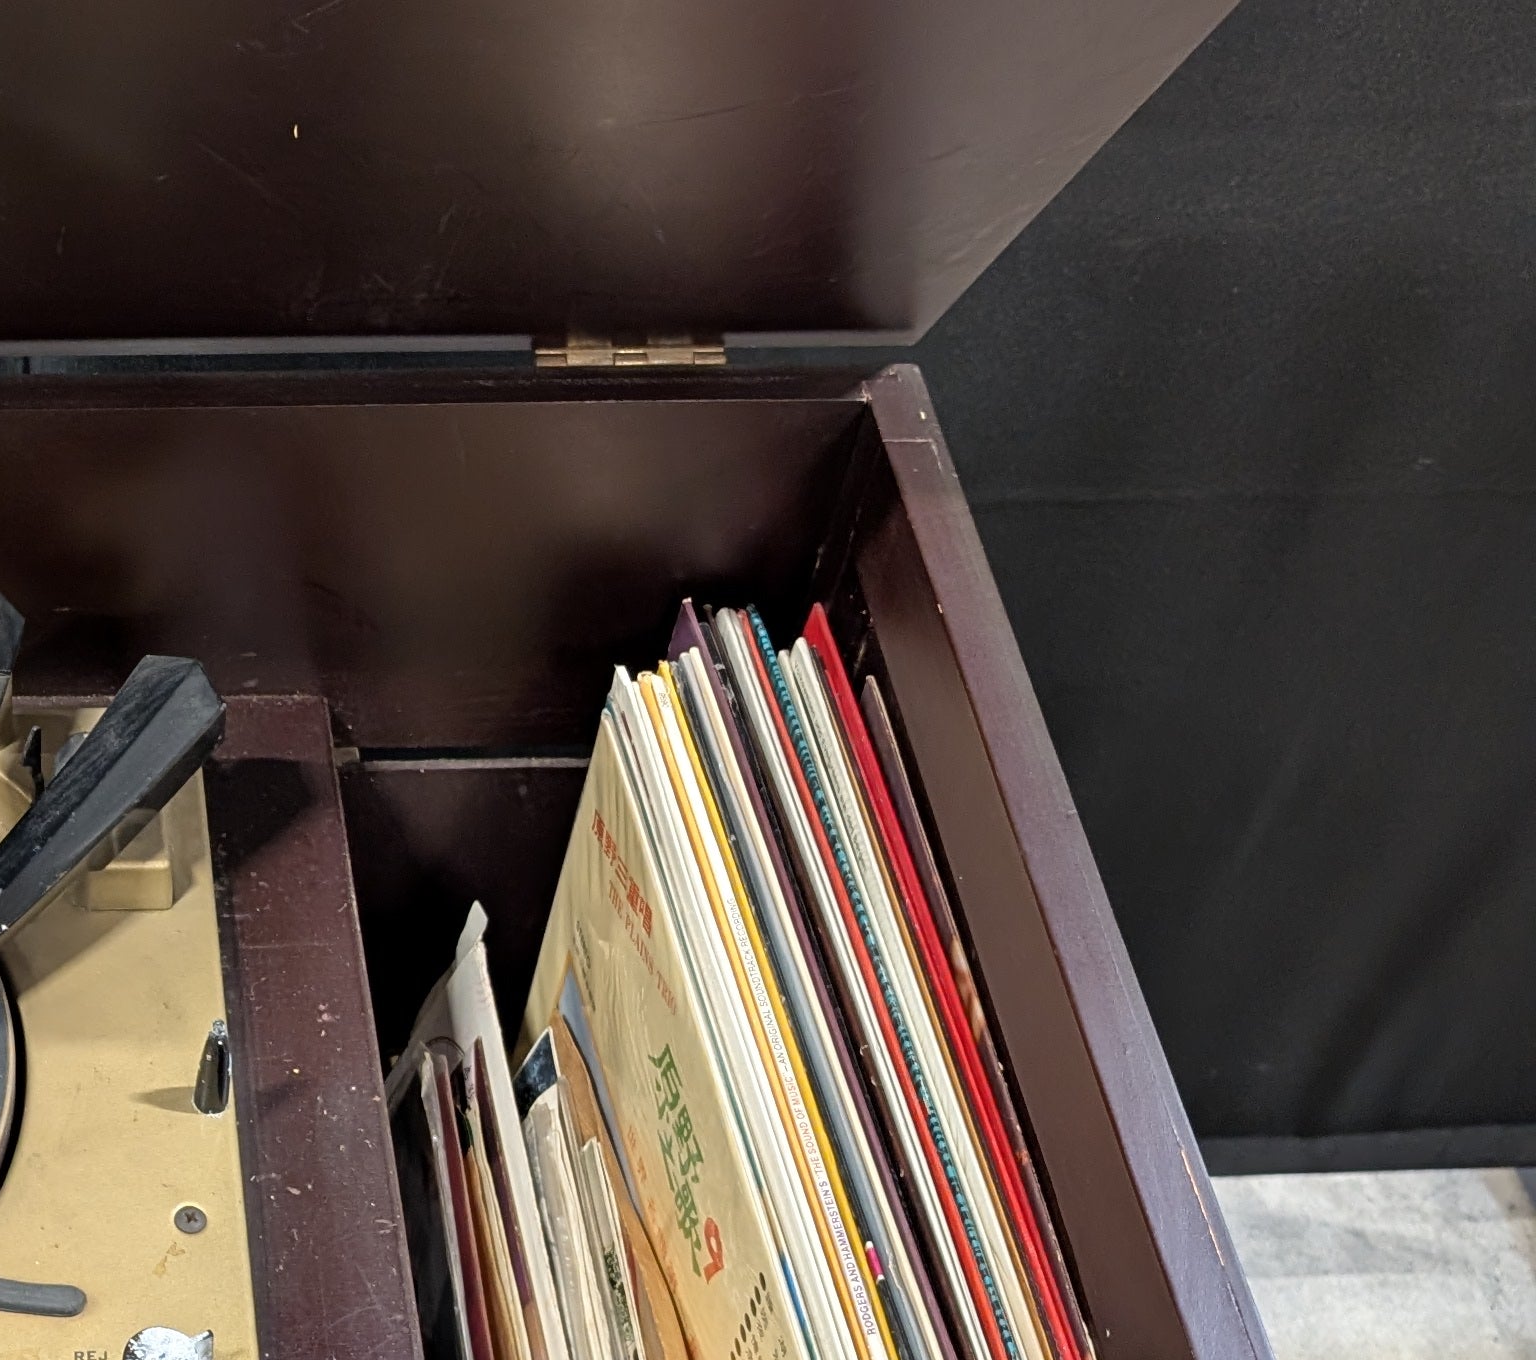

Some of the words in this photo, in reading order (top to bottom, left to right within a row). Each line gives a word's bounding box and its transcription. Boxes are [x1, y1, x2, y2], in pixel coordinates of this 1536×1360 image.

[607, 879, 624, 919] THE
[624, 915, 655, 975] PLAINS
[727, 897, 749, 948] RECORDING
[744, 948, 769, 1007] SOUNDTRACK
[762, 1008, 783, 1051] ORIGINAL
[793, 1107, 806, 1120] OF
[799, 1120, 817, 1155] SOUND
[818, 1180, 855, 1263] HAMMERSTEIN'S
[846, 1261, 862, 1283] AND
[853, 1285, 876, 1335] RODGERS
